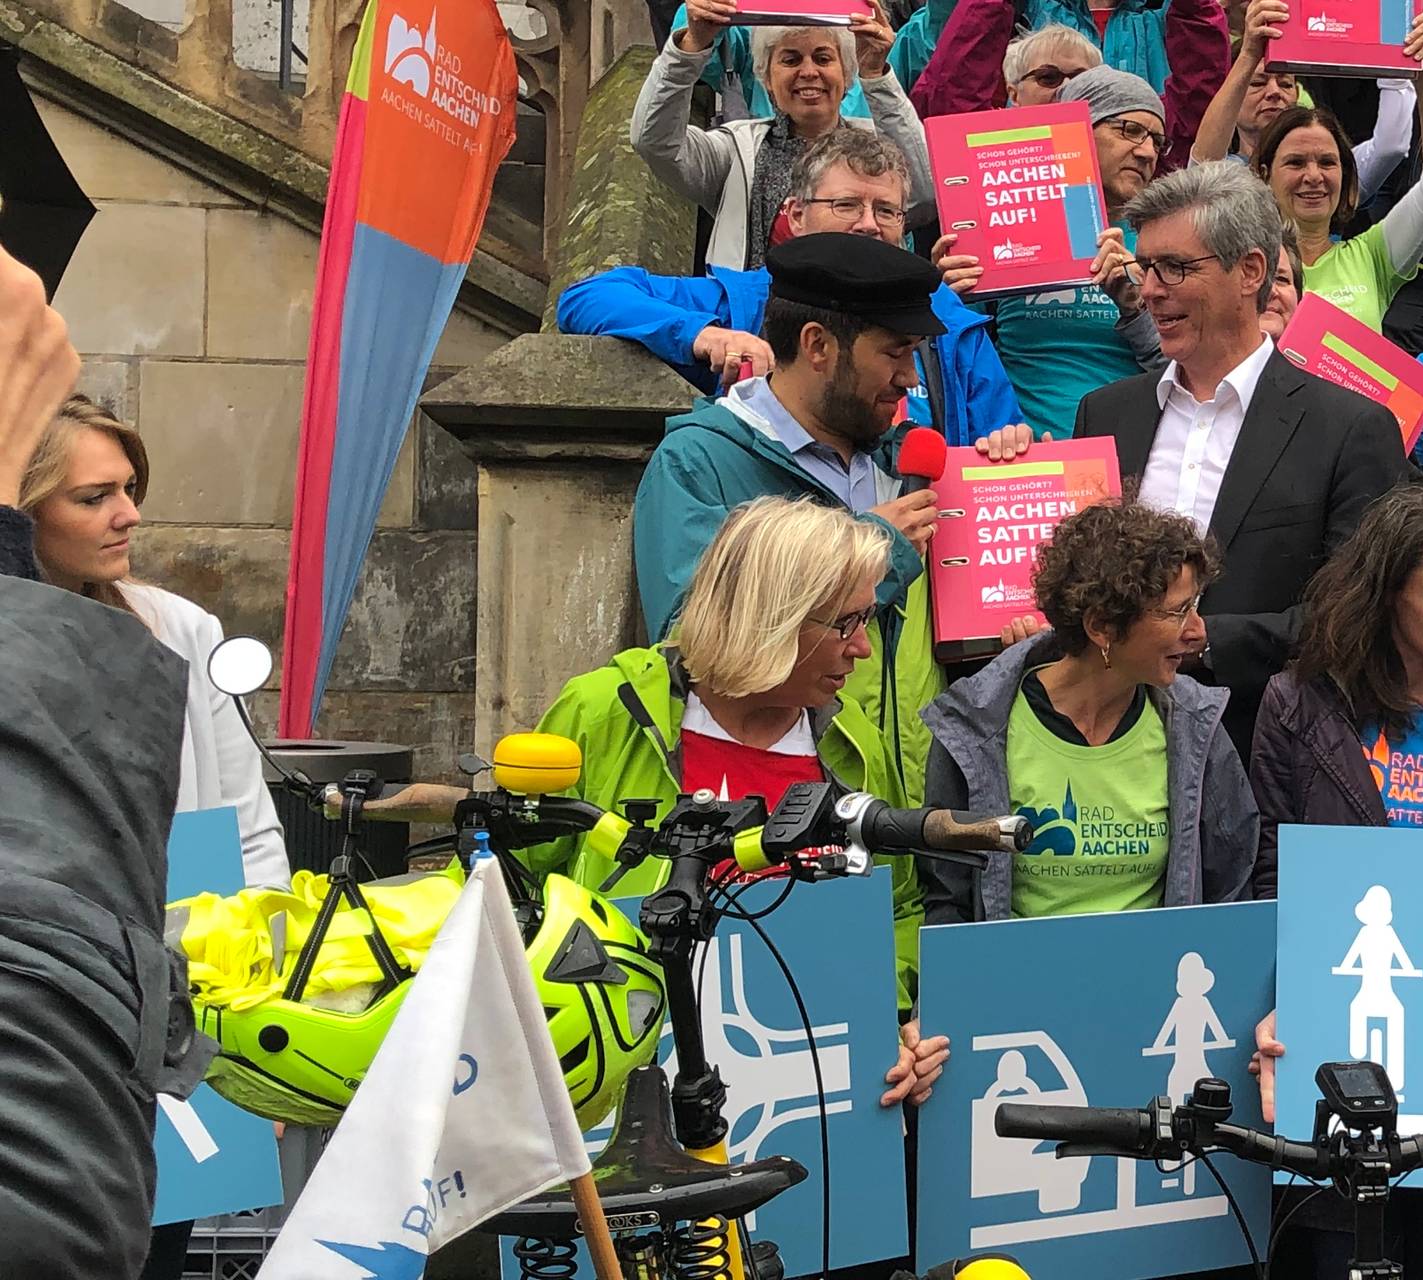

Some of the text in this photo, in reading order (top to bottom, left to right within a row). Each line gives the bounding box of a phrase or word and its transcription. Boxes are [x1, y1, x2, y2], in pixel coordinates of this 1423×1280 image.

[436, 45, 462, 74] RAD
[434, 65, 501, 115] ENTSCHD
[431, 87, 480, 128] AACHEN
[381, 88, 483, 156] AACHEN SATTELT AF!
[976, 149, 1005, 160] SCHON
[978, 160, 1007, 169] SCHON
[982, 163, 1066, 188] AACHEN
[985, 183, 1069, 207] SATTELT
[989, 207, 1037, 228] AUF!
[1317, 362, 1343, 383] SCHON
[1321, 353, 1348, 374] SCHON
[972, 485, 1006, 494] SCHON
[973, 495, 1007, 504] SCHON
[975, 500, 1077, 522] AACHEN
[977, 523, 1054, 544] SATTE
[979, 546, 1038, 566] AUF!
[1080, 806, 1115, 822] RAD
[1081, 821, 1168, 839] ENTSCHEID
[1081, 840, 1149, 856] AACHEN
[1015, 863, 1156, 877] AACHEN SATTELT AUF!
[609, 1214, 642, 1229] OOKS
